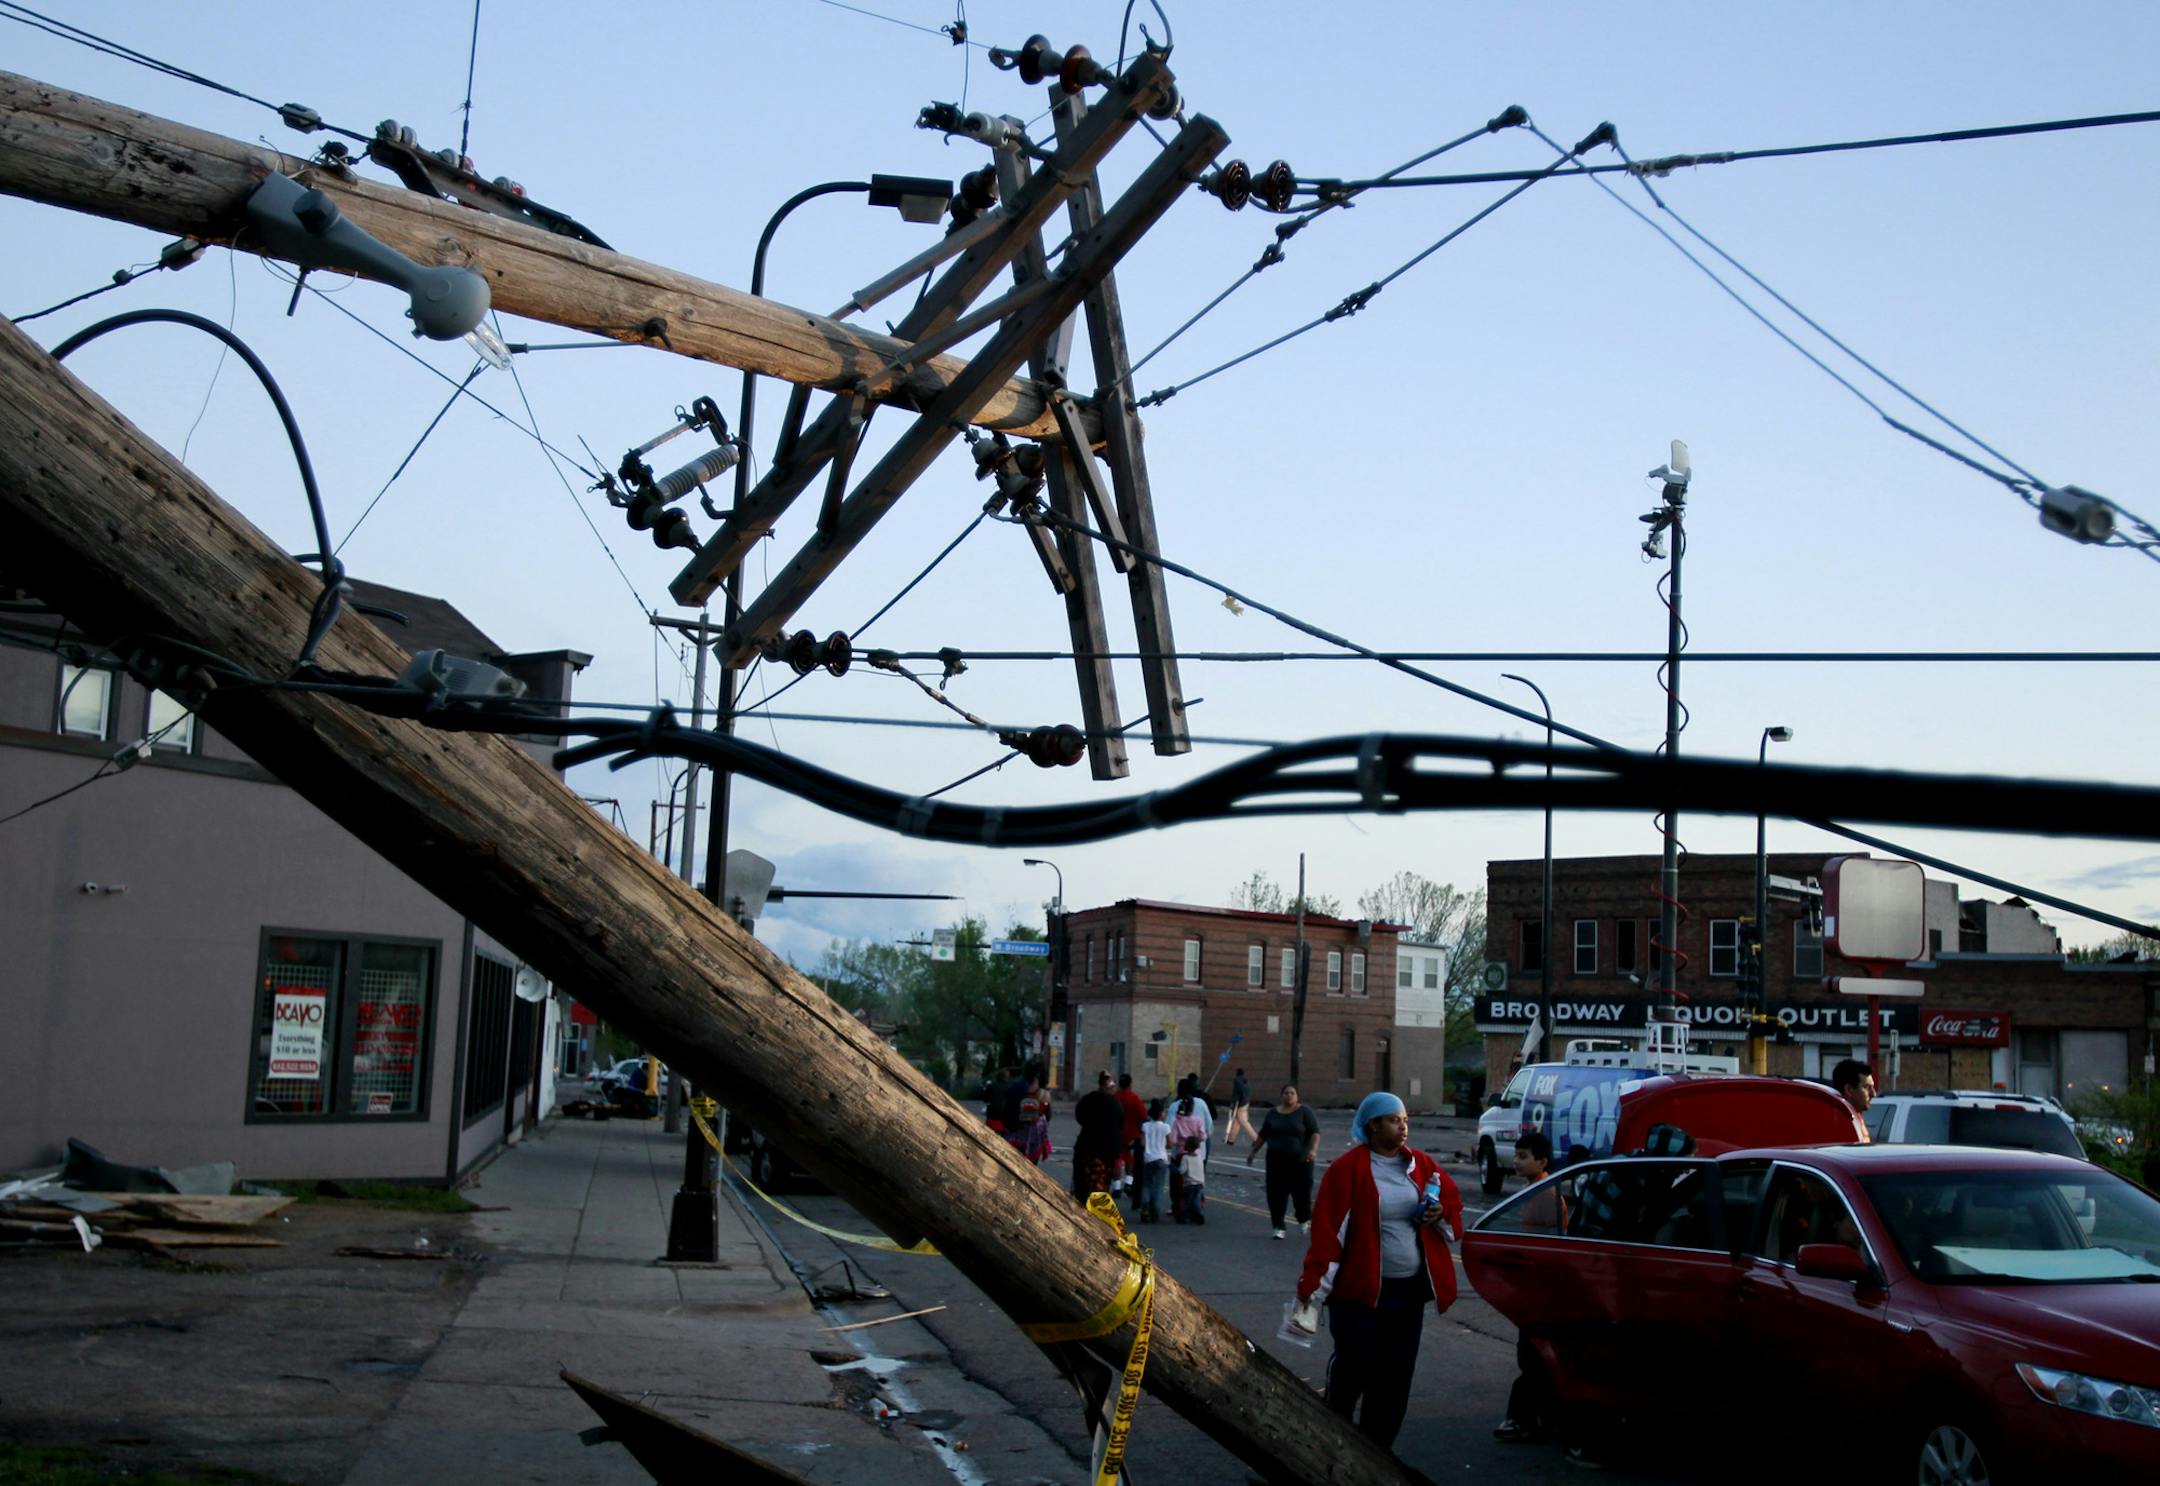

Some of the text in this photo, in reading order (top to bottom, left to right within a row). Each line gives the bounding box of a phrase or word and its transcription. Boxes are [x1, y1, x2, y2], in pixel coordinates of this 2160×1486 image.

[1647, 1005, 1742, 1025] LQUO
[1778, 1007, 1896, 1027] OUTLET
[1927, 1015, 2000, 1038] Coca-a
[278, 1033, 315, 1045] Everything
[1534, 1074, 1559, 1096] FOX
[1532, 1103, 1545, 1134] 9
[1551, 1078, 1629, 1159] FOX
[1124, 1369, 1141, 1386] DO
[1116, 1391, 1136, 1422] LINE
[1104, 1426, 1129, 1475] POLICE
